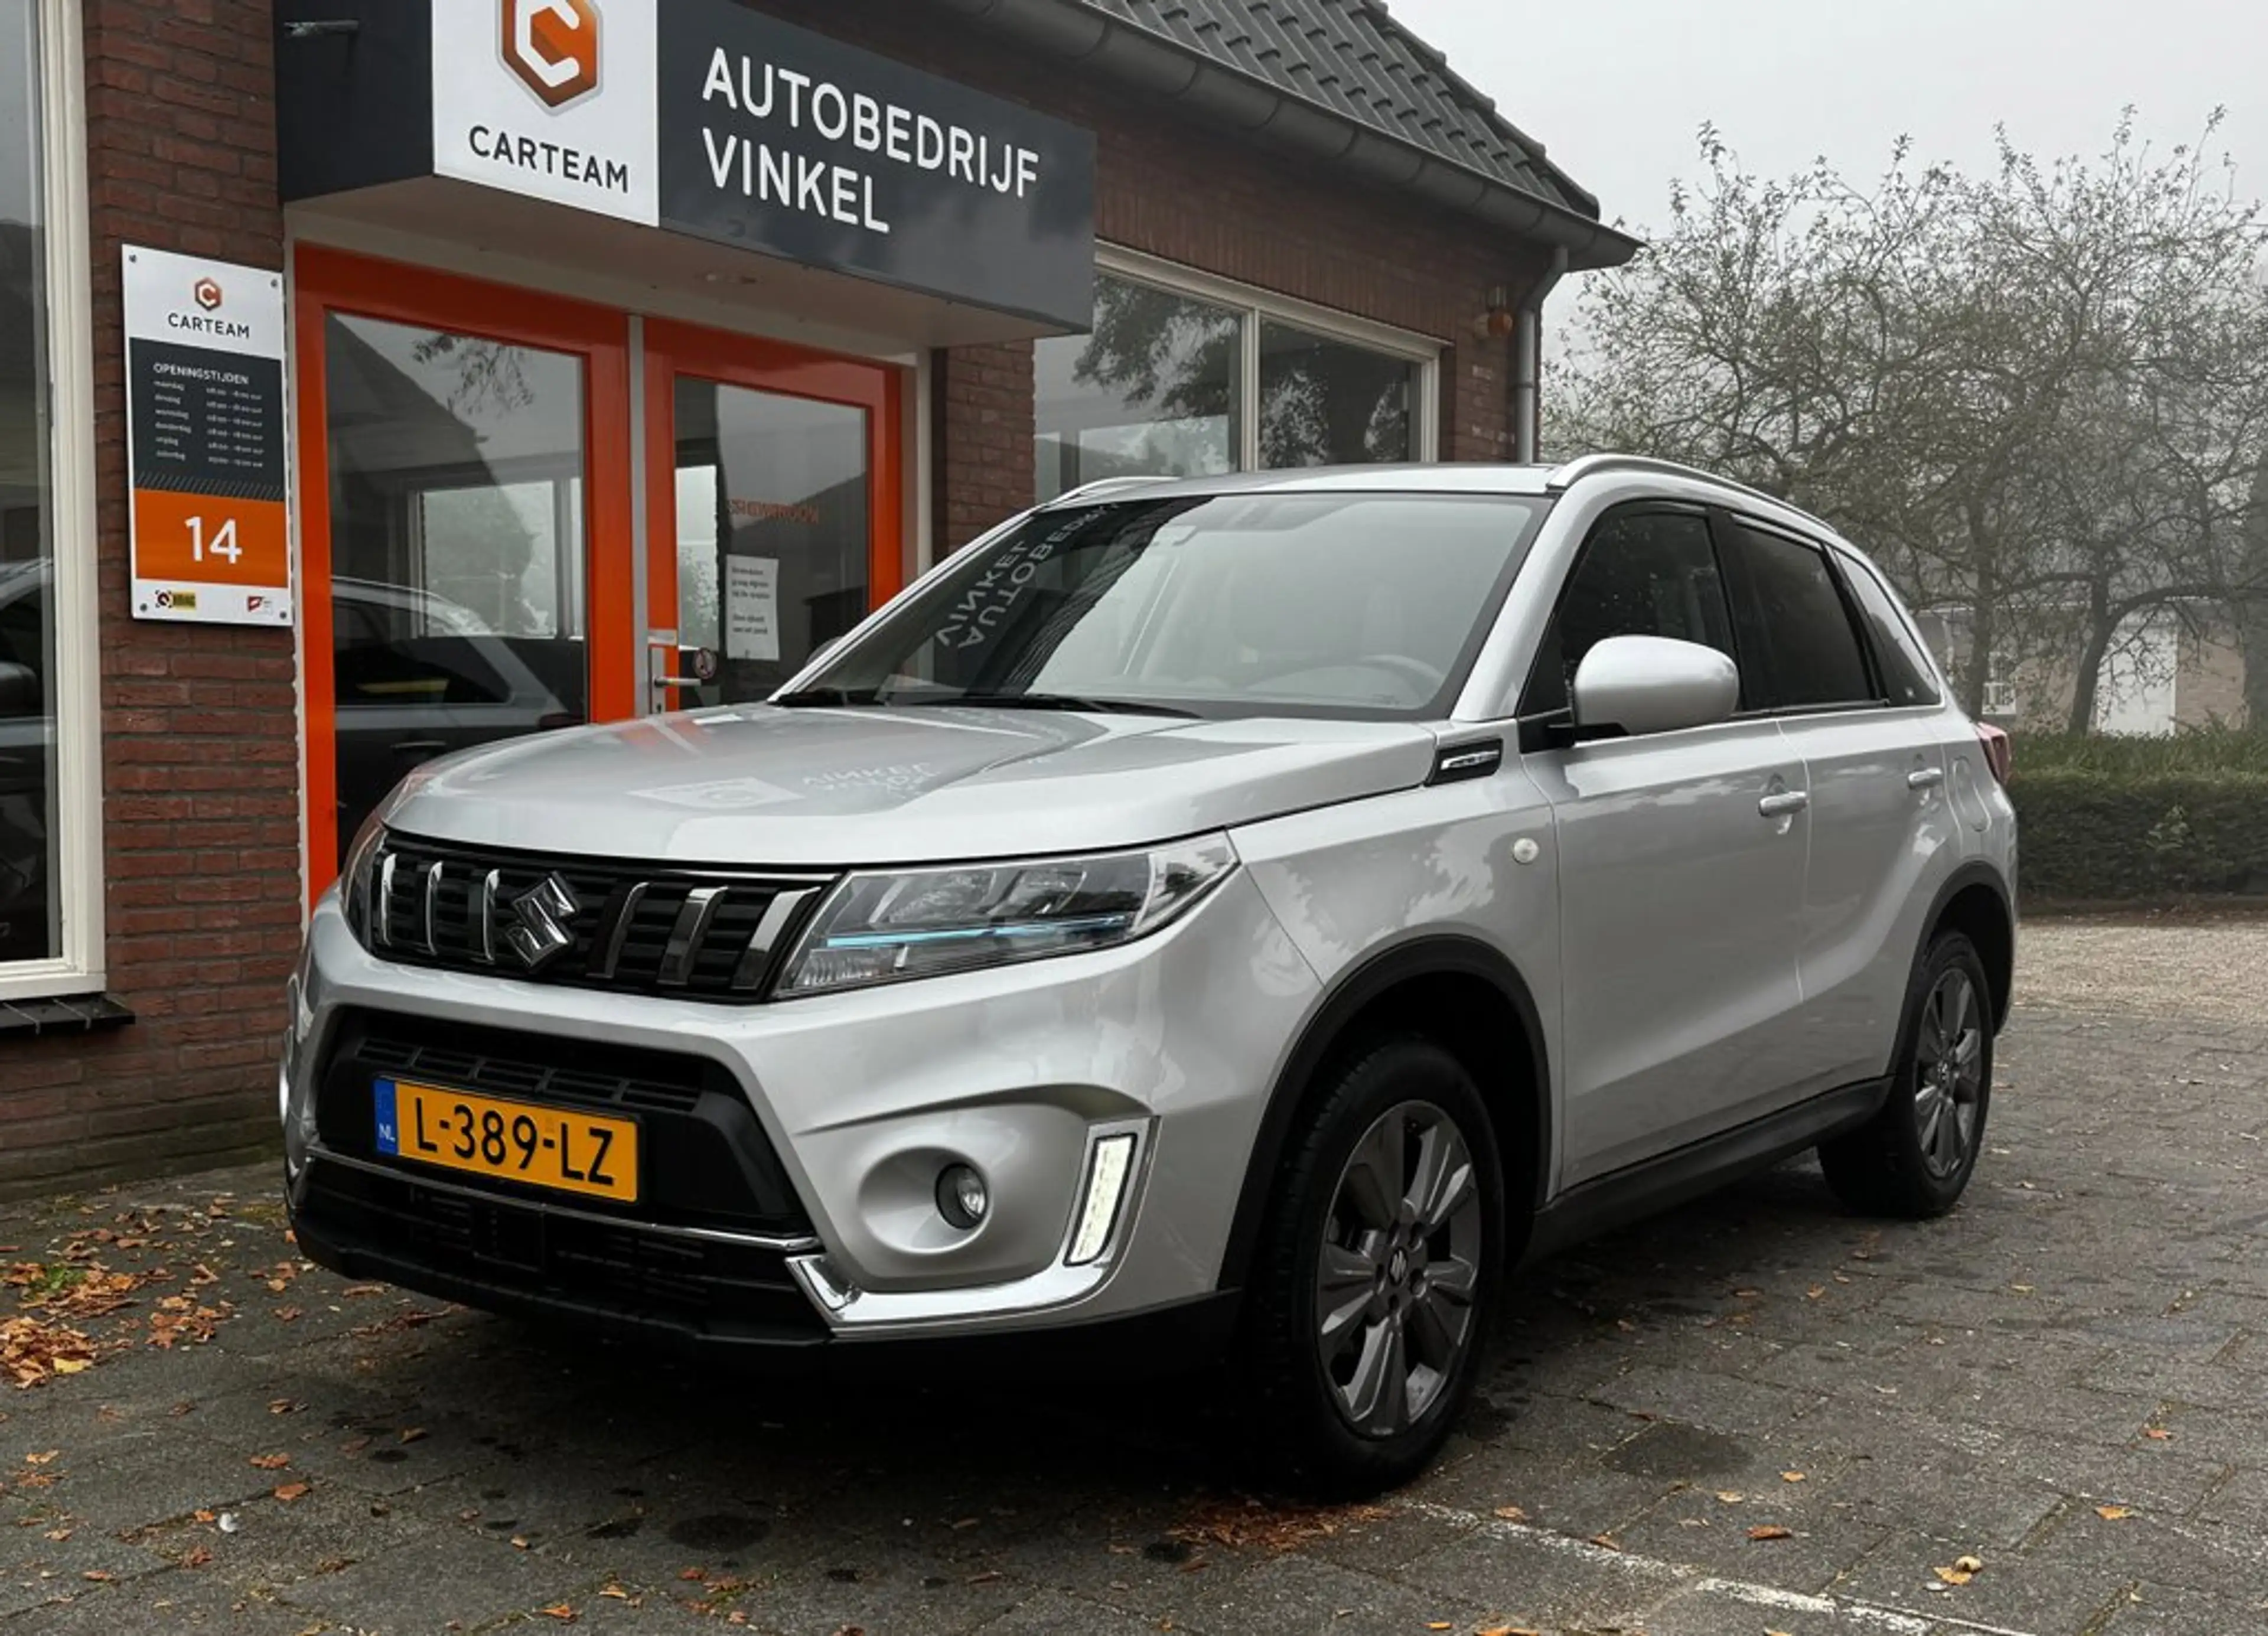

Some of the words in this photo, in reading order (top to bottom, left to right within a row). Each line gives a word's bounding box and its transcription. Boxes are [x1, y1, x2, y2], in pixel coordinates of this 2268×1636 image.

[702, 48, 1039, 198] AUTOBEDRIJF
[470, 126, 628, 193] CARTEAM
[703, 128, 889, 233] VINKEL
[168, 312, 249, 339] CARTEAM
[185, 516, 242, 564] 14
[379, 1123, 396, 1142] NL
[415, 1097, 614, 1187] L-389-LZ
